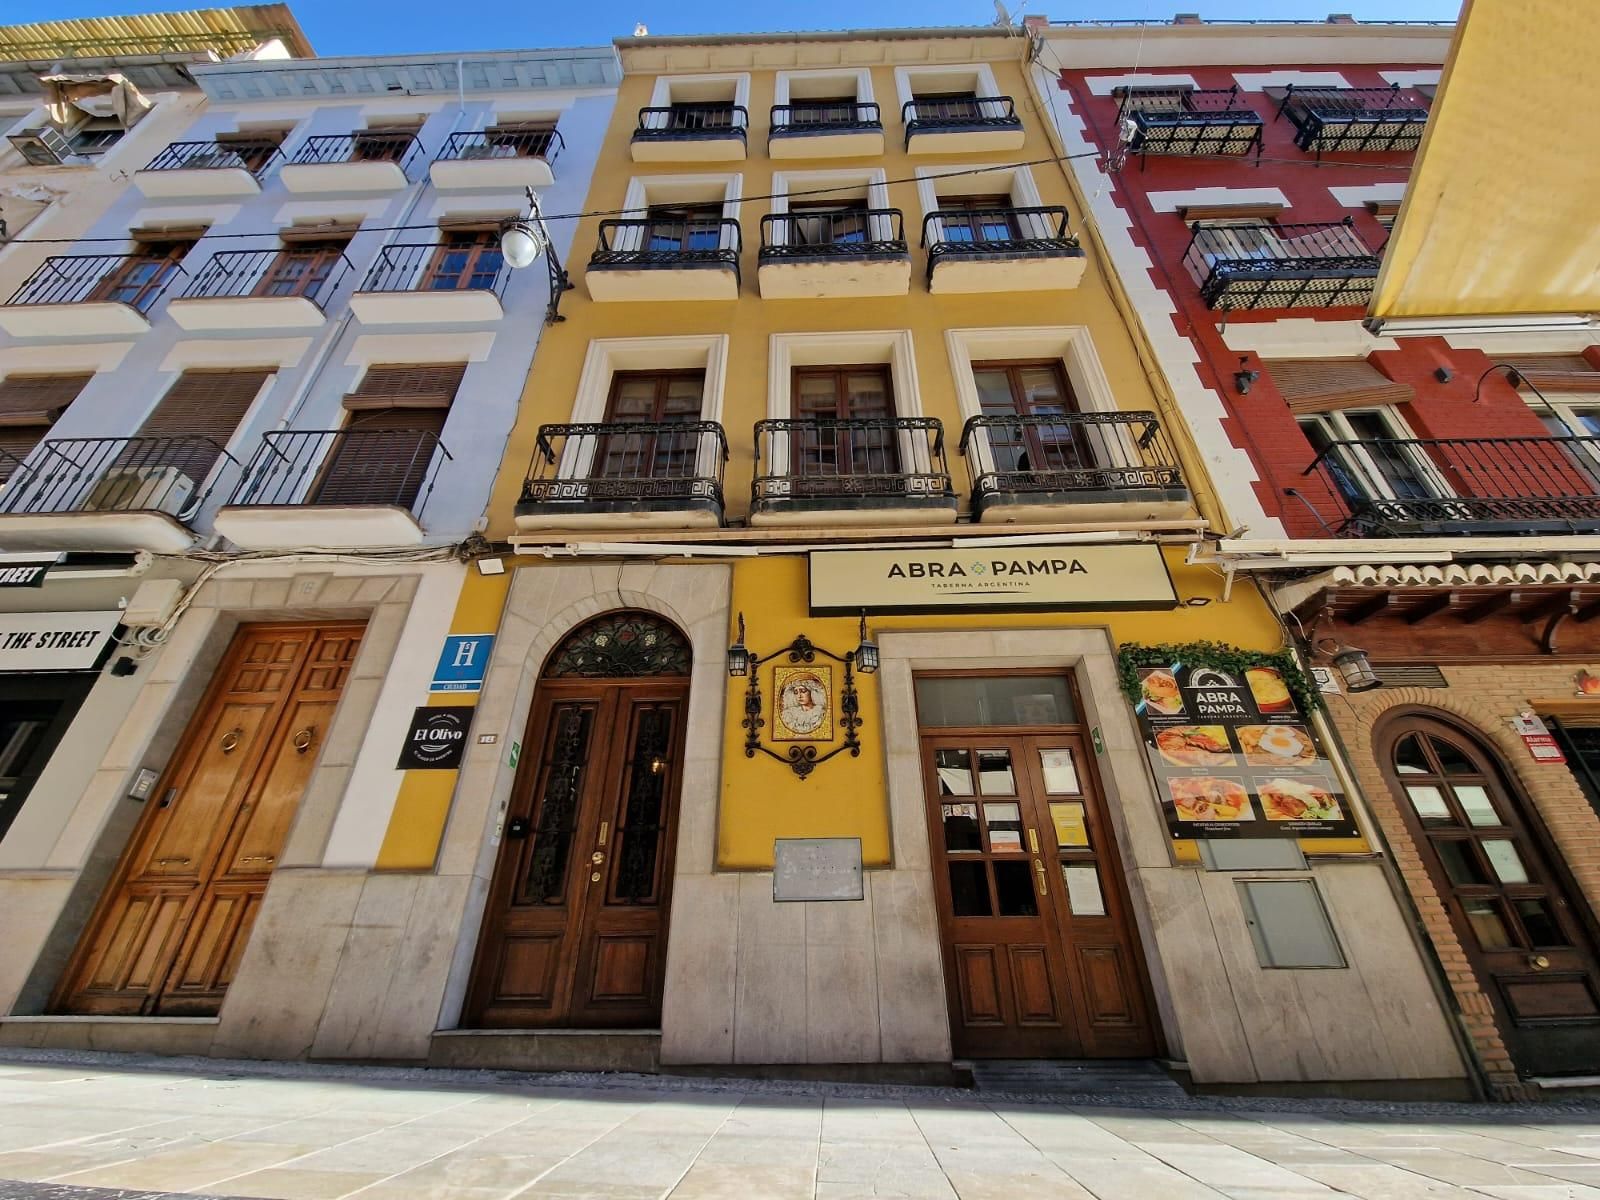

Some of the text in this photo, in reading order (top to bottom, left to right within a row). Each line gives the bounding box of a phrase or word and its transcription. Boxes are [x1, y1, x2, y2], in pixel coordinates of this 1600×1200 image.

[0, 566, 43, 583] TREET
[887, 559, 1088, 578] ABRA PAMPA
[2, 631, 100, 649] THE STREET
[1196, 693, 1241, 703] ABRA
[1199, 704, 1245, 714] PAMPA
[413, 728, 462, 741] El Olivo
